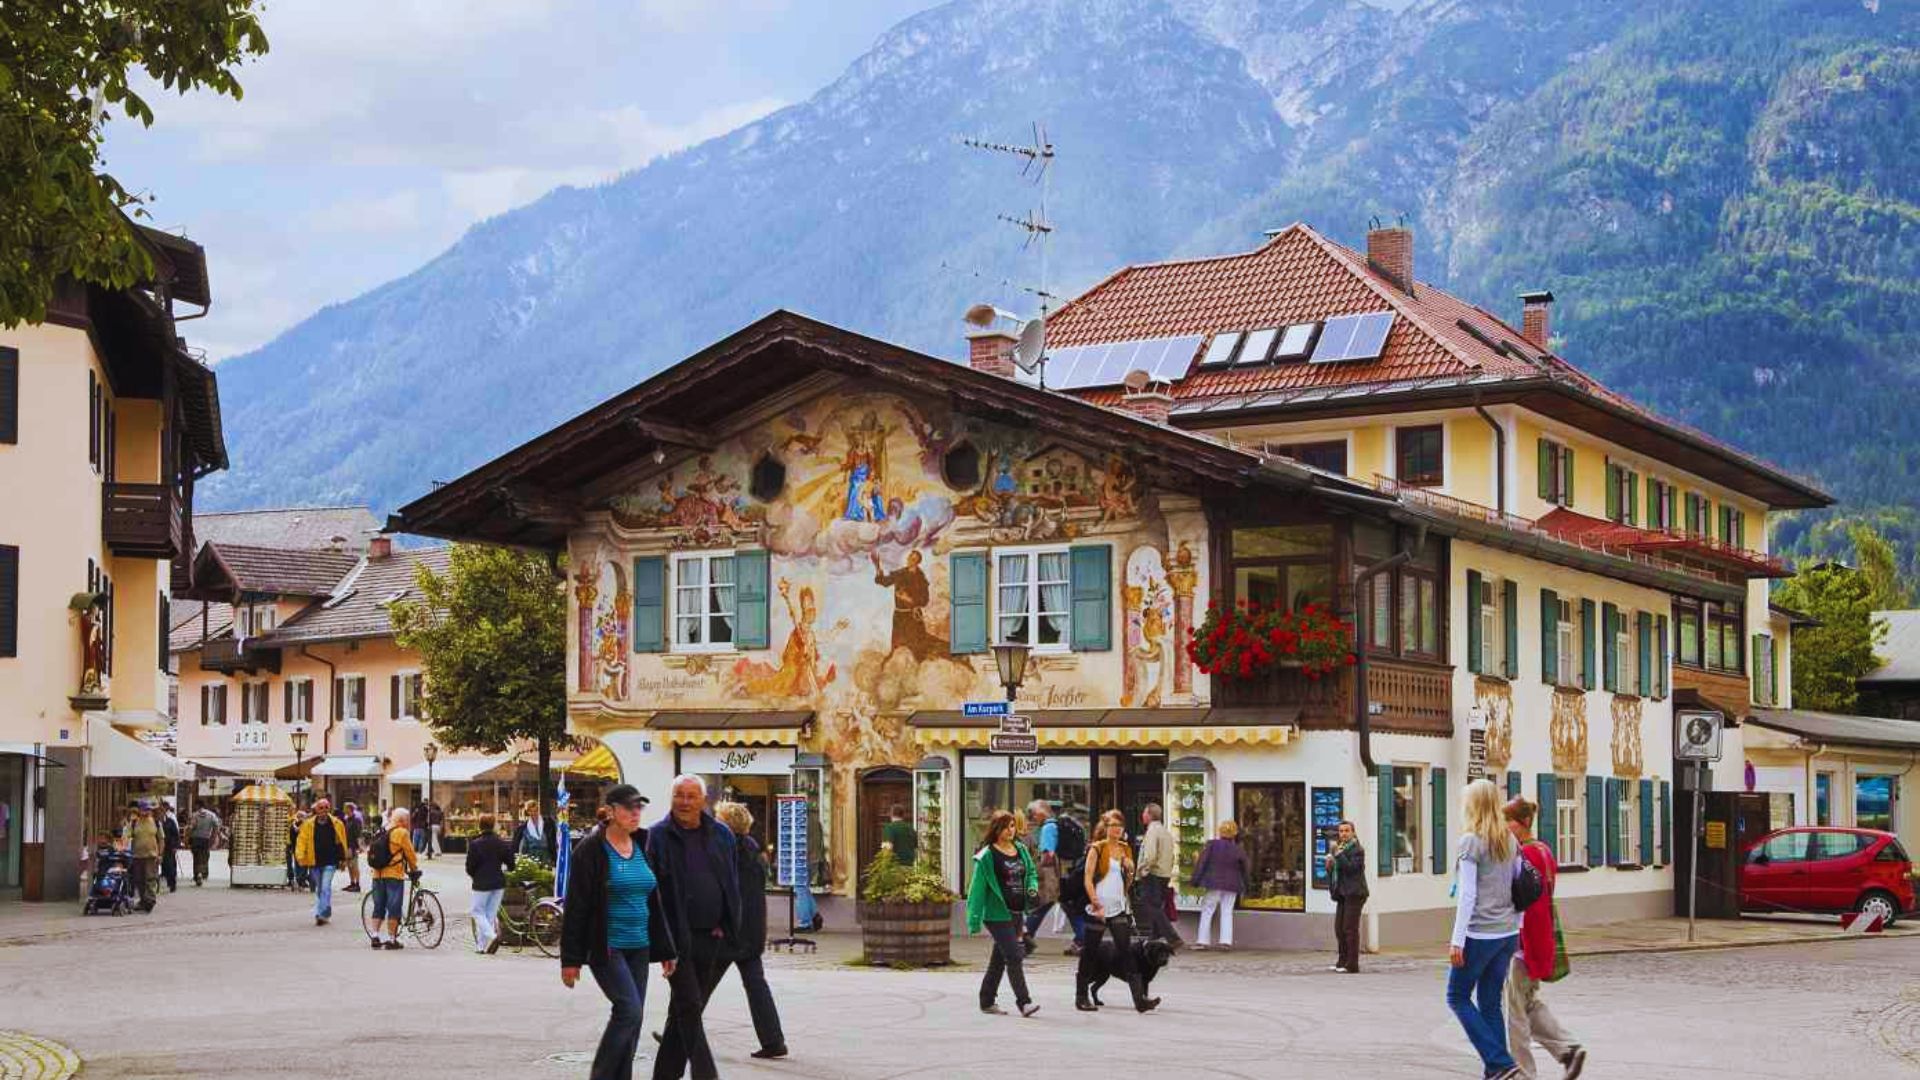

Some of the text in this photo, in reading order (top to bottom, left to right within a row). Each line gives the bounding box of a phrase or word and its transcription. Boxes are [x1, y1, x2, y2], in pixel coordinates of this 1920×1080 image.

[967, 704, 1004, 716] Am Kurpark
[235, 731, 268, 744] aran
